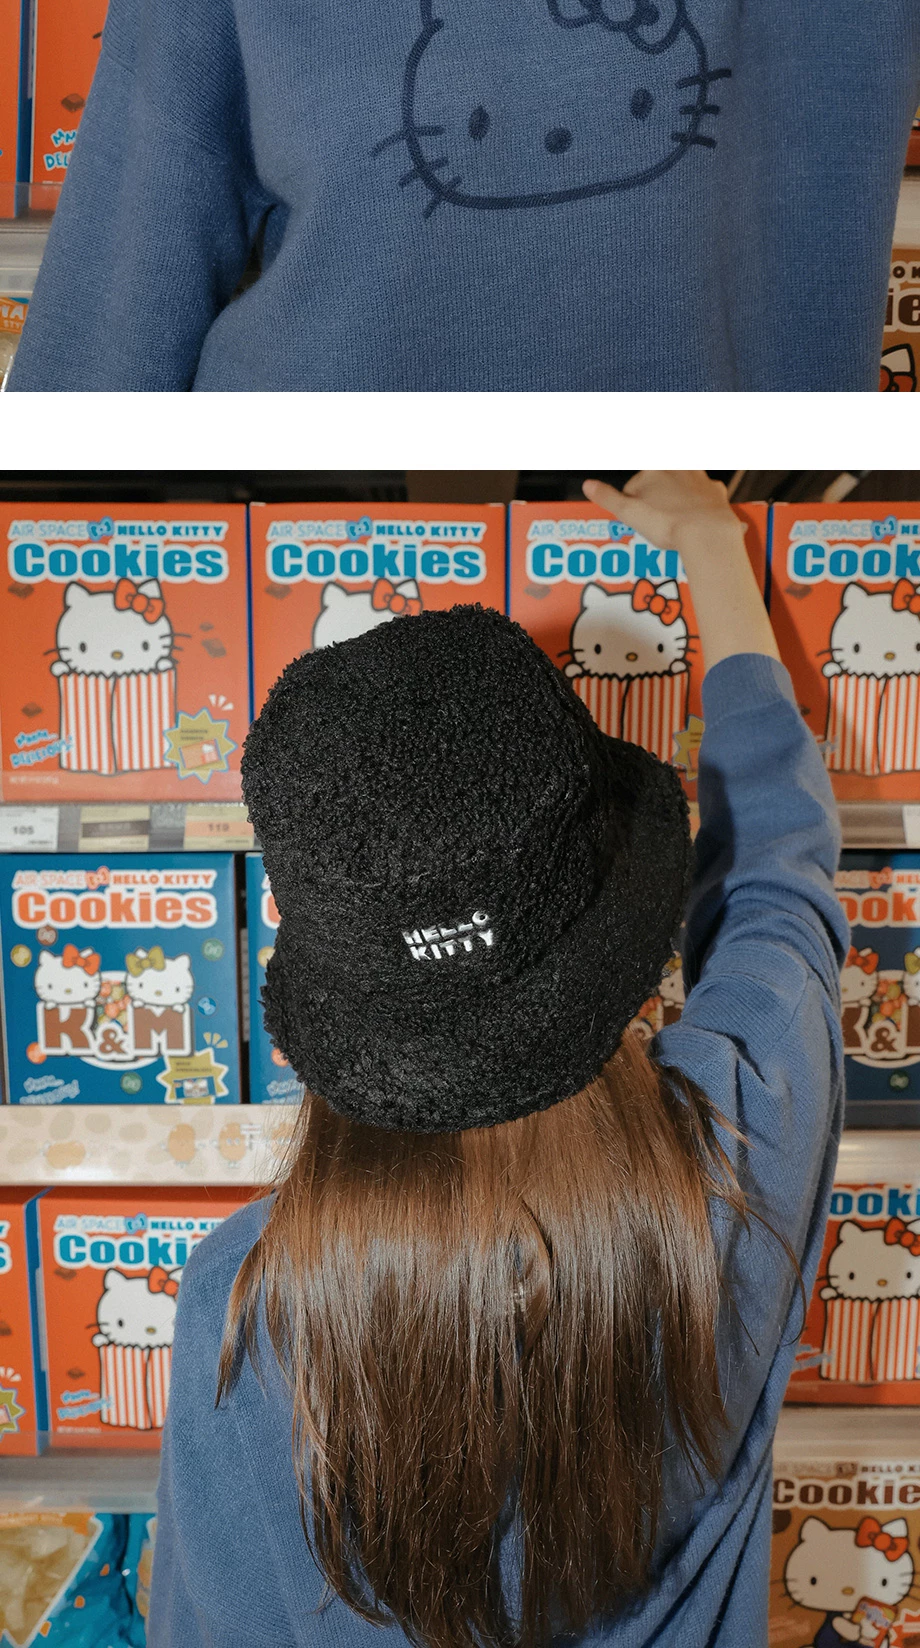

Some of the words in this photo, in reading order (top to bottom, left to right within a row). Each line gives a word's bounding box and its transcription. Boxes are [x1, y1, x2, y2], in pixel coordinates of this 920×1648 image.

[11, 524, 35, 537] AIR
[39, 523, 86, 537] SPACE
[117, 525, 167, 536] HELLO
[172, 525, 224, 537] KITTY
[270, 524, 294, 538] AIR
[297, 523, 345, 538] SPACE
[376, 524, 426, 537] HELLO
[431, 526, 481, 538] KITTY
[531, 523, 555, 537] AIR
[558, 523, 607, 538] SPACE
[821, 523, 869, 538] SPACE
[14, 543, 223, 578] Cookies
[271, 543, 481, 579] Cookies
[531, 543, 686, 578] Cooki
[13, 826, 35, 835] 105
[112, 873, 159, 885] HELLO
[164, 873, 214, 885] KITTY
[17, 891, 213, 924] Cookies
[401, 909, 490, 945] HELLO
[409, 928, 494, 961] KITTY
[43, 1007, 185, 1054] K&M
[150, 1220, 194, 1231] HELLO
[58, 1234, 198, 1266] Cooki
[861, 1463, 903, 1474] HELLO
